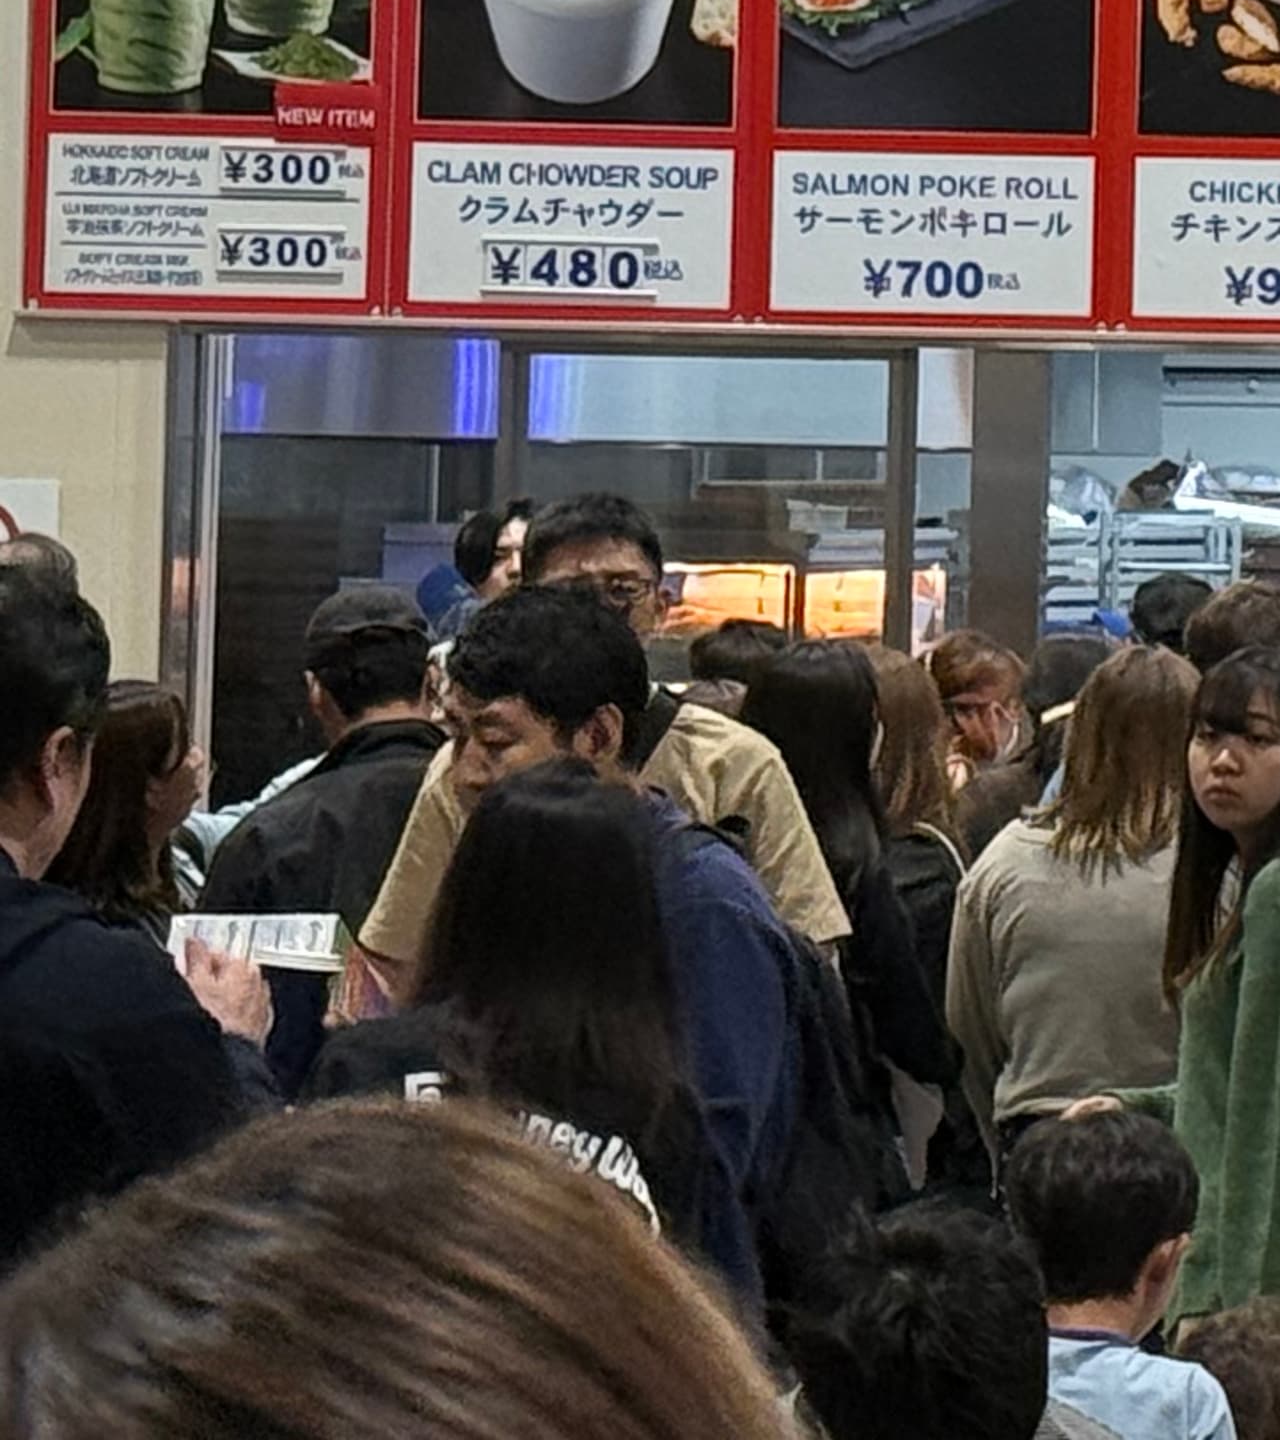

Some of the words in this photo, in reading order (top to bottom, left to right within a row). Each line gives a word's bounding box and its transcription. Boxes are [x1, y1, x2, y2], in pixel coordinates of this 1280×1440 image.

[277, 106, 326, 126] NEW
[328, 109, 375, 128] ITEM
[427, 160, 501, 185] CLAM
[509, 162, 640, 188] CHOWDER
[648, 166, 719, 190] SOUP
[792, 172, 909, 197] SALMON
[919, 174, 996, 198] POKE
[1005, 177, 1079, 200] ROLL
[459, 194, 684, 228] クラムチャウダー
[794, 205, 1073, 239] サーモンポキロール
